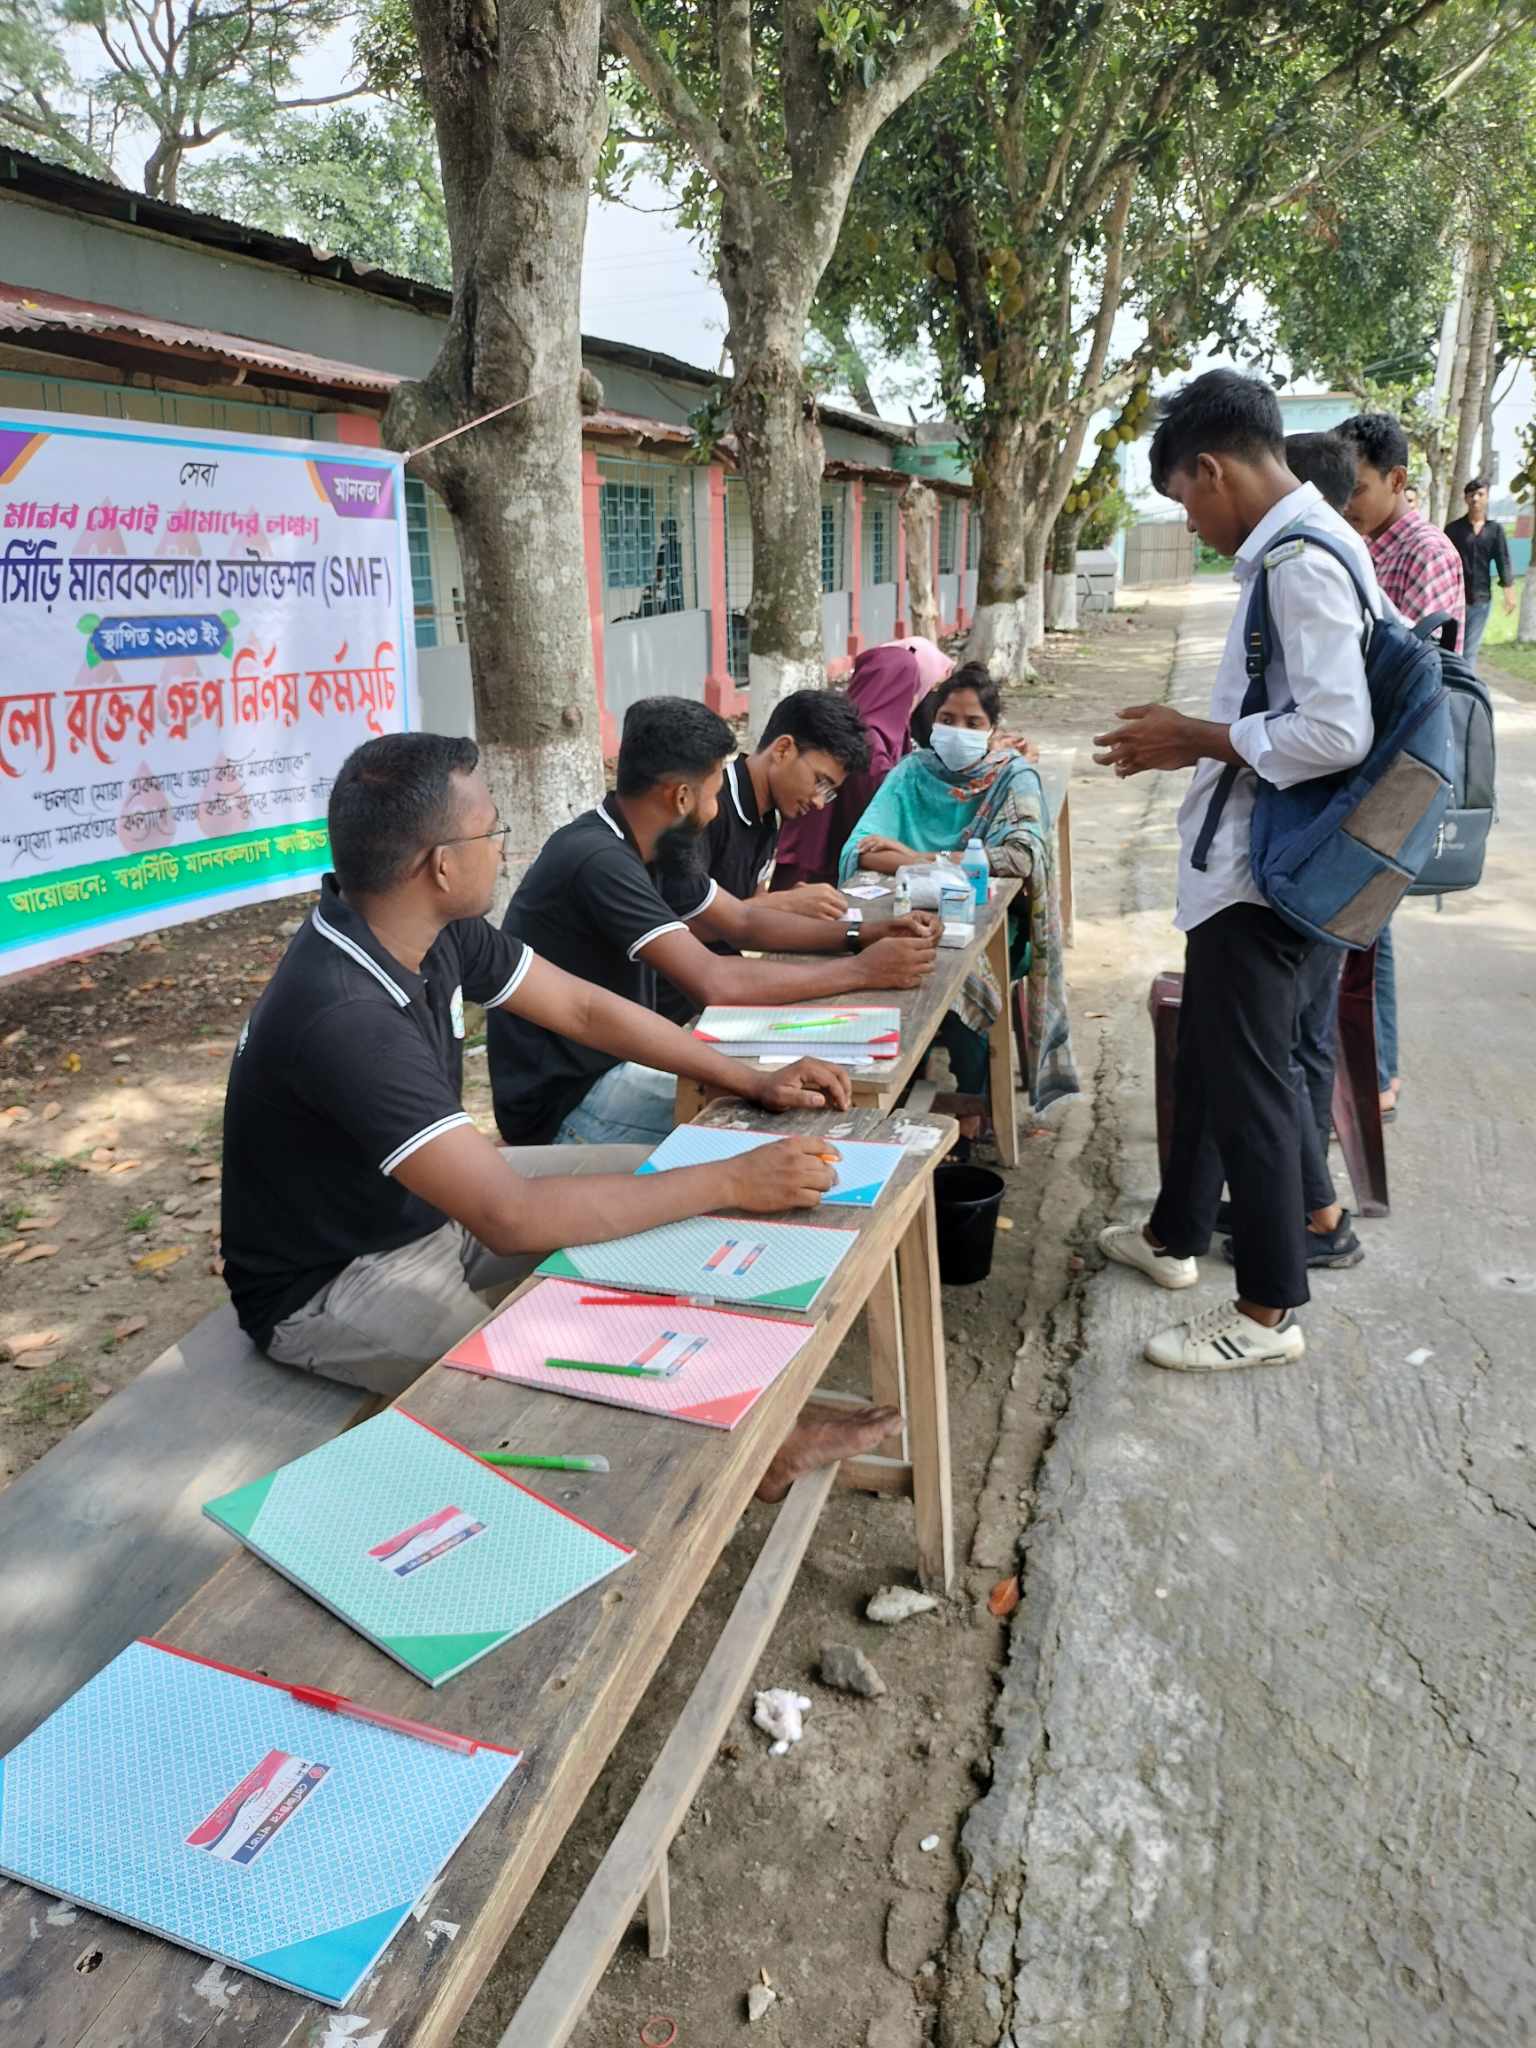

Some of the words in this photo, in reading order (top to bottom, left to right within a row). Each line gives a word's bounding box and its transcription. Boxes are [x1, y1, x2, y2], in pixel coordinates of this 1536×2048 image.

[180, 461, 219, 488] সেবা
[334, 476, 382, 504] মানবতা
[3, 502, 80, 529] মানব
[86, 502, 160, 535] সেবাই
[166, 509, 260, 538] আমাদের
[266, 515, 319, 544] লক্ষ্য
[69, 558, 211, 601] মানবকল্যাণ
[216, 547, 317, 599] ফাউন্ডেশন
[322, 555, 392, 609] (SMF)
[100, 621, 150, 654] স্থাপিত
[154, 626, 198, 650] ২০২৩
[201, 621, 222, 648] ইং
[64, 684, 157, 765] রক্তের
[167, 679, 224, 740] গ্রুপ
[231, 644, 300, 727] নির্ণয়
[305, 637, 395, 736] কর্মসূচি
[112, 851, 181, 892] স্বপ্নসিঁড়ি
[183, 837, 272, 873] মানবকল্যাণ
